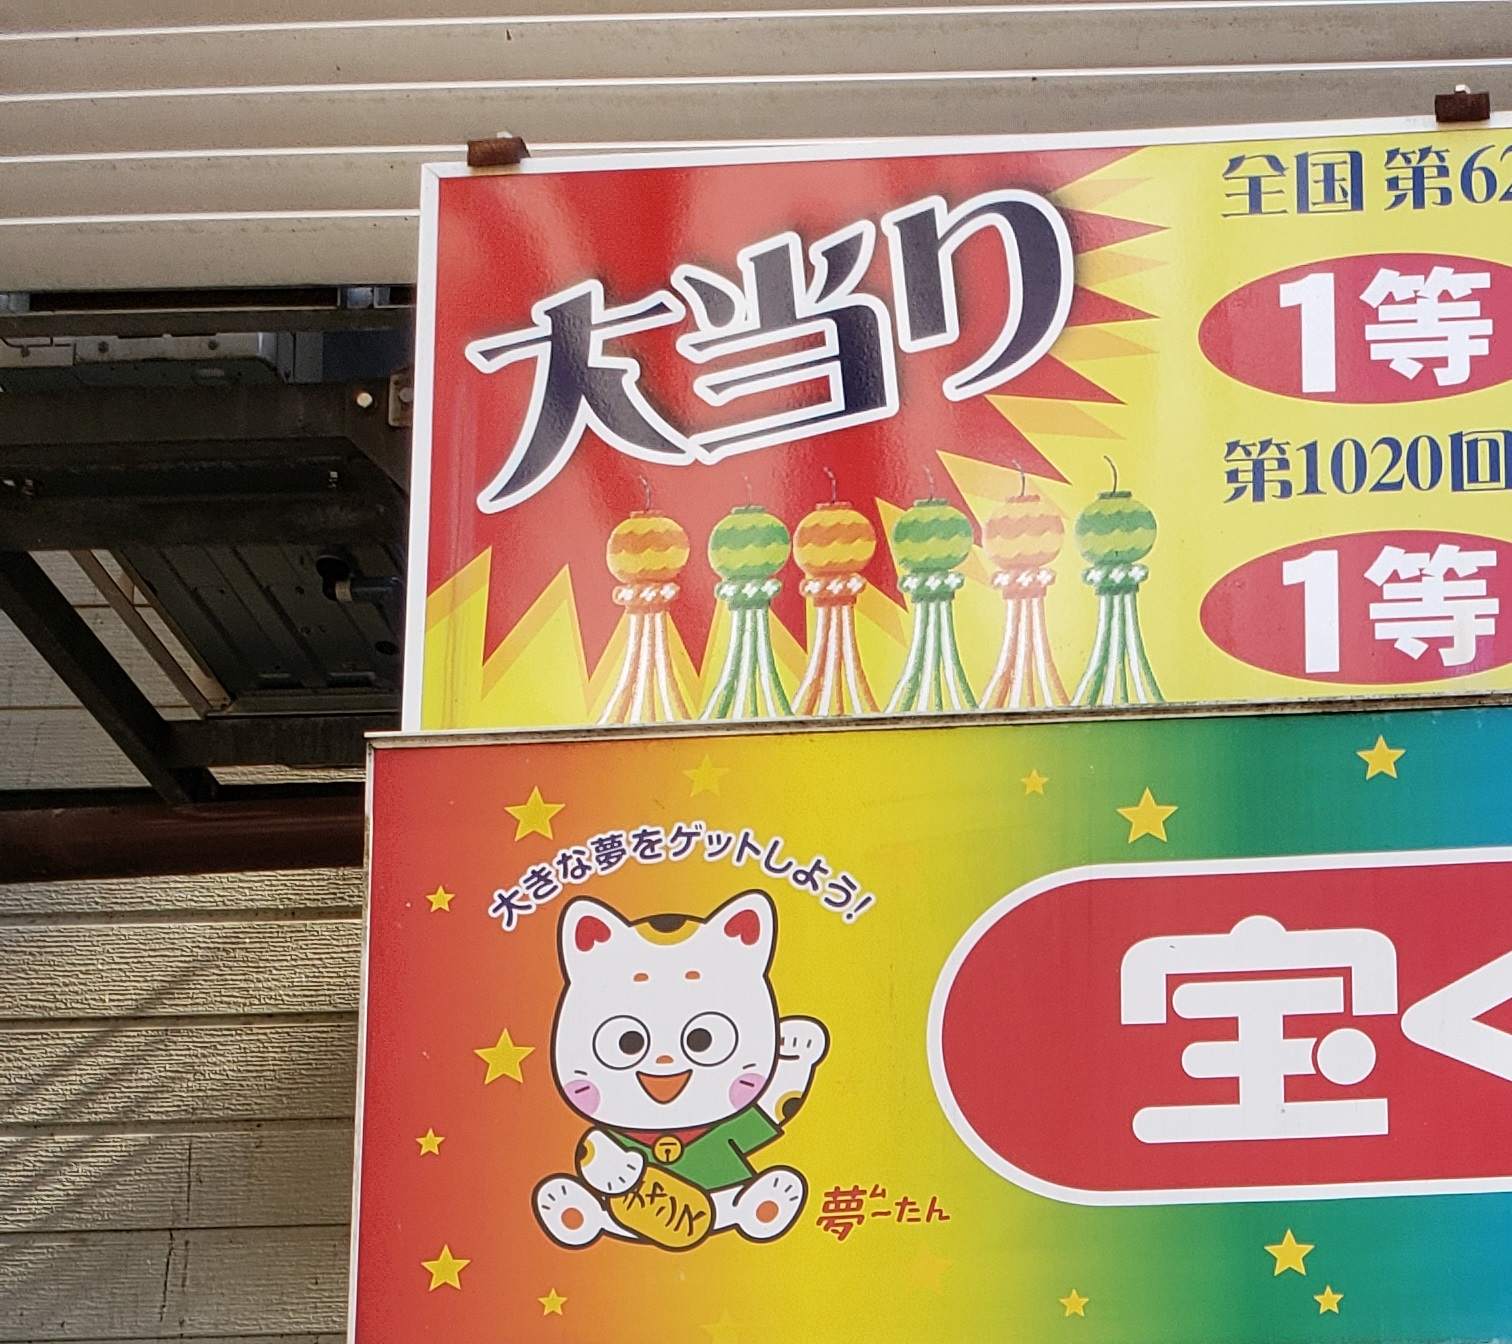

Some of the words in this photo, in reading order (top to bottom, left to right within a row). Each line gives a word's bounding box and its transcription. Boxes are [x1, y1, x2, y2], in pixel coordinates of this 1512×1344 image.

[1221, 148, 1364, 218] 全国
[466, 188, 1075, 514] 大当り
[1279, 266, 1494, 393] 1等
[1282, 545, 1499, 674] 1等
